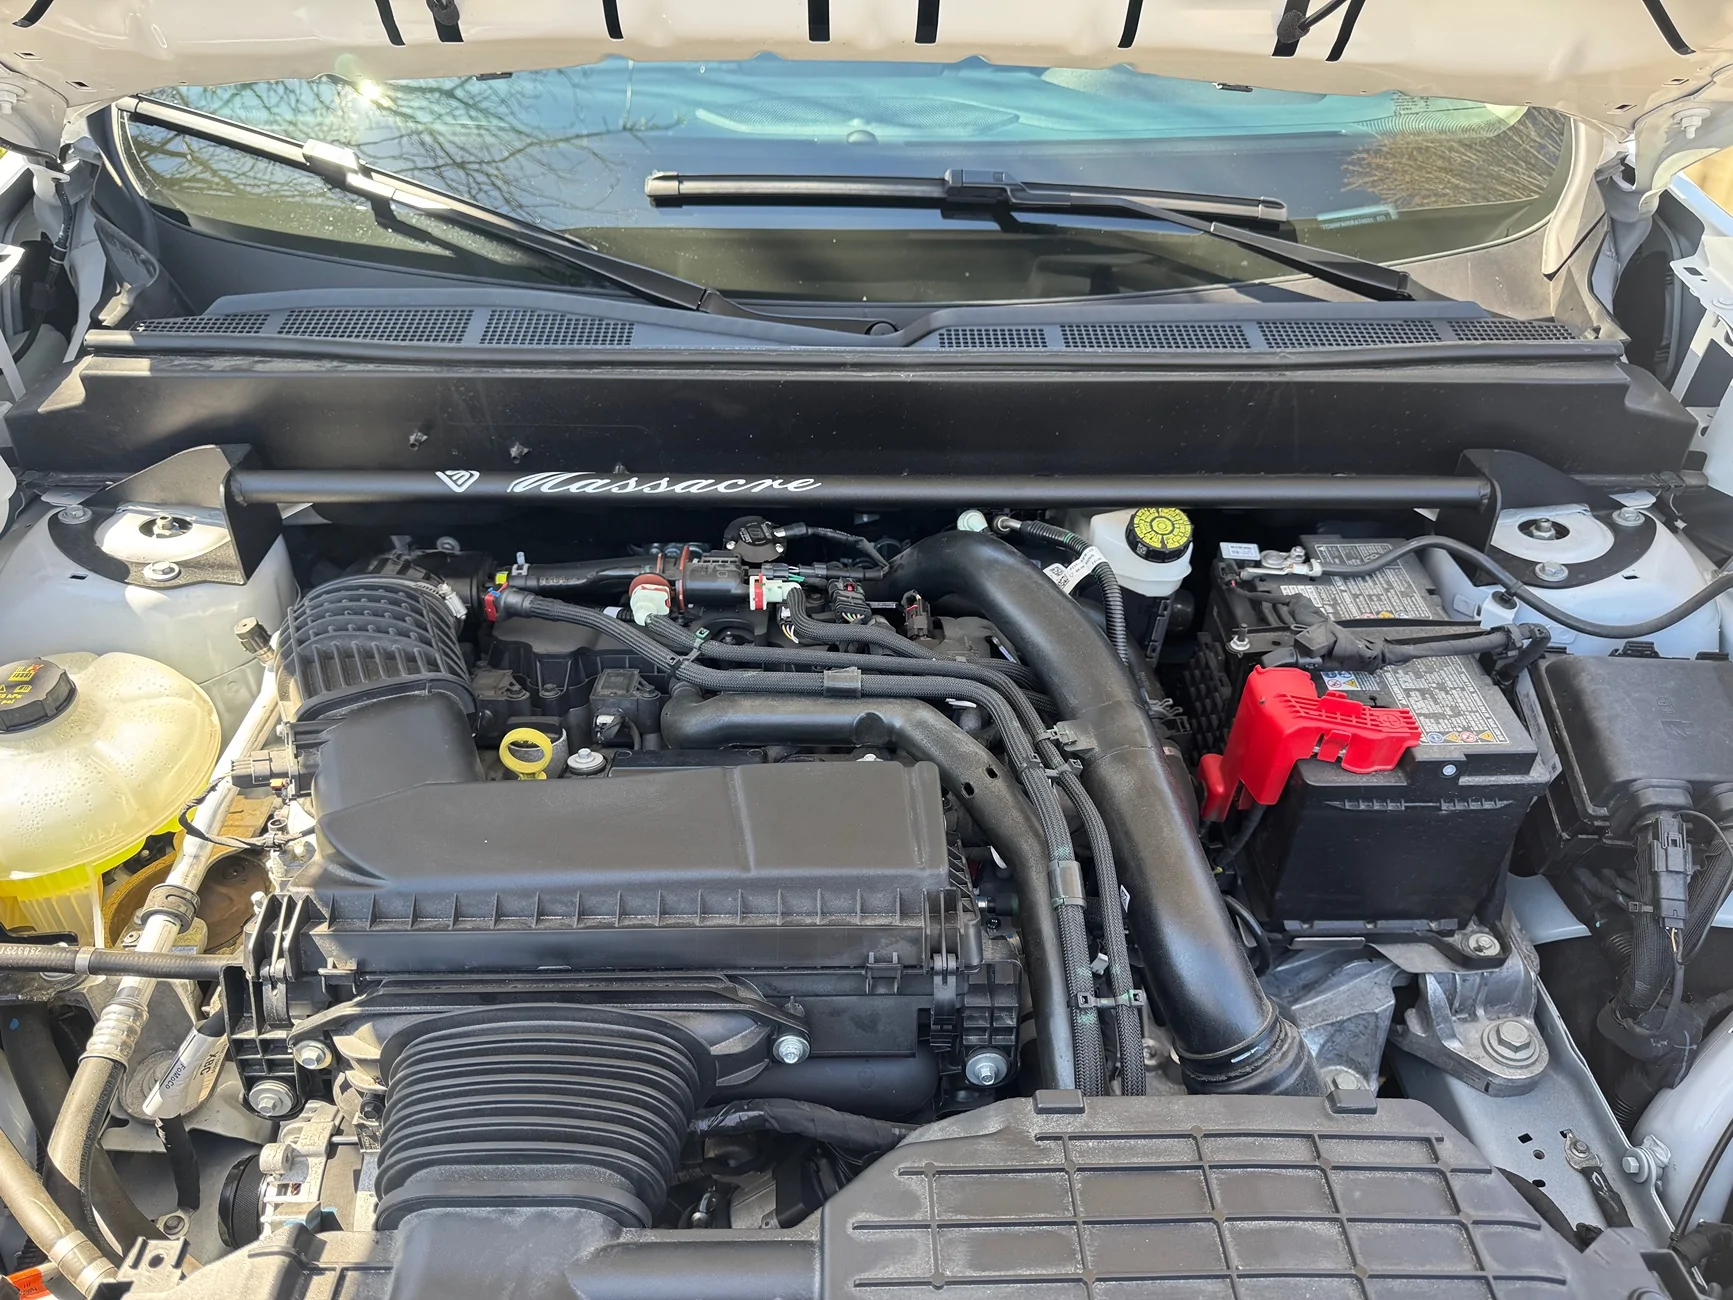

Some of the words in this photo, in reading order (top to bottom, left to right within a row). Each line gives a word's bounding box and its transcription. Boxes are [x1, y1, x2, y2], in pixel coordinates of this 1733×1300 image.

[507, 471, 823, 494] Massacre
[200, 1051, 220, 1076] XBC
[165, 1063, 187, 1090] FoMoCo
